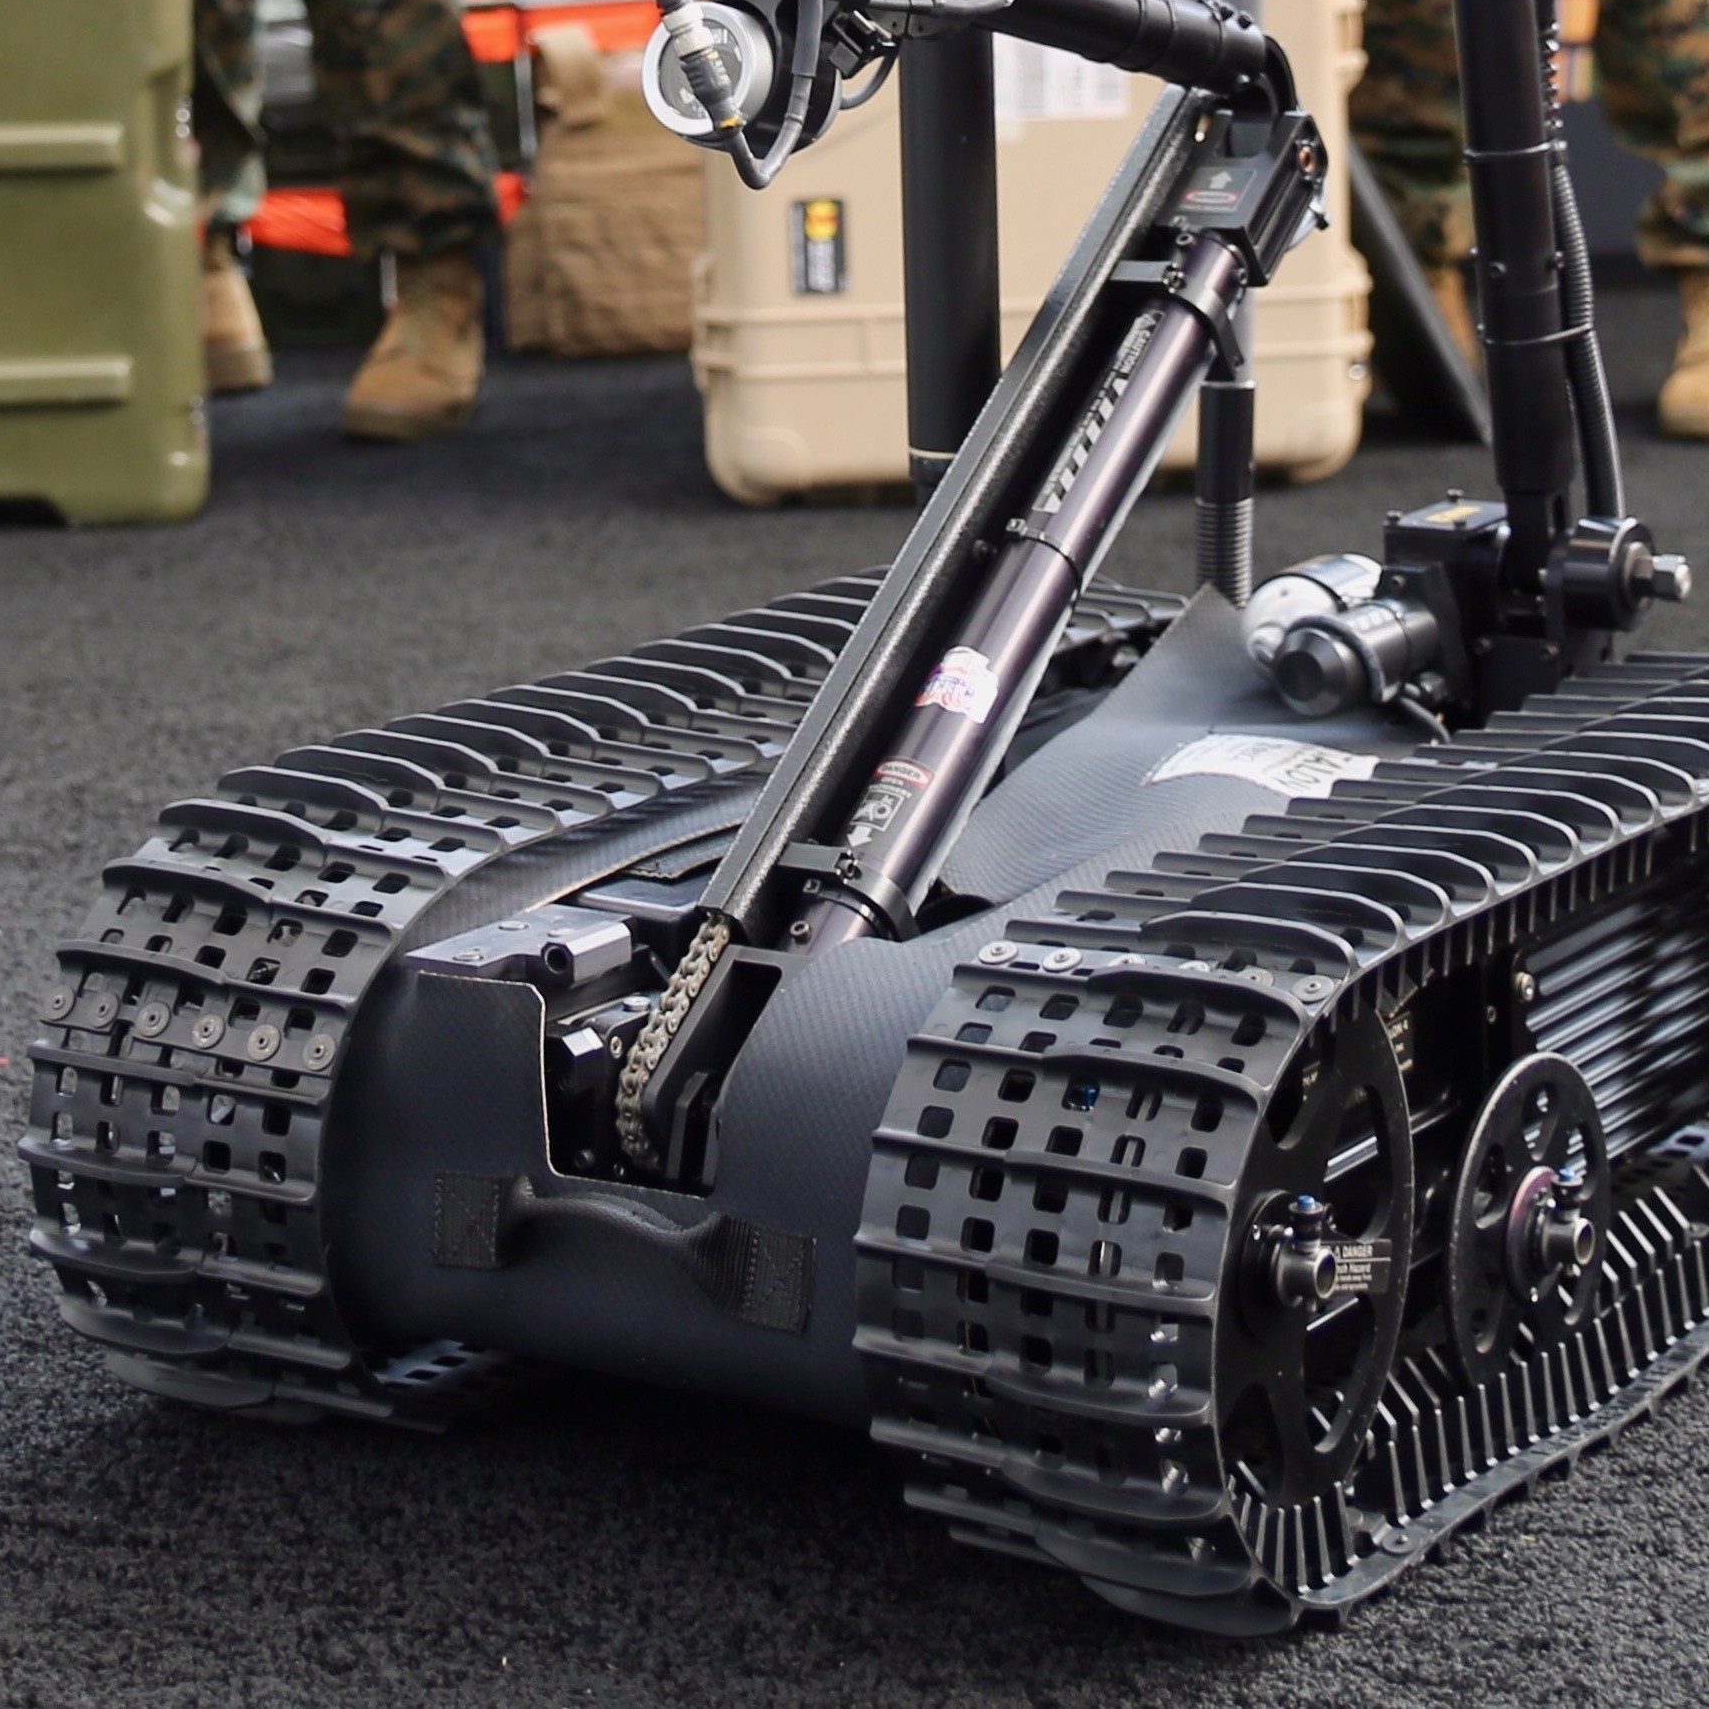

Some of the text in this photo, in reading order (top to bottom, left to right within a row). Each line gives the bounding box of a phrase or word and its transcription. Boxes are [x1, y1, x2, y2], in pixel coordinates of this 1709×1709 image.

[1119, 327, 1151, 374] CAUTION
[879, 762, 924, 780] DANGER
[1342, 1244, 1374, 1258] DANGER
